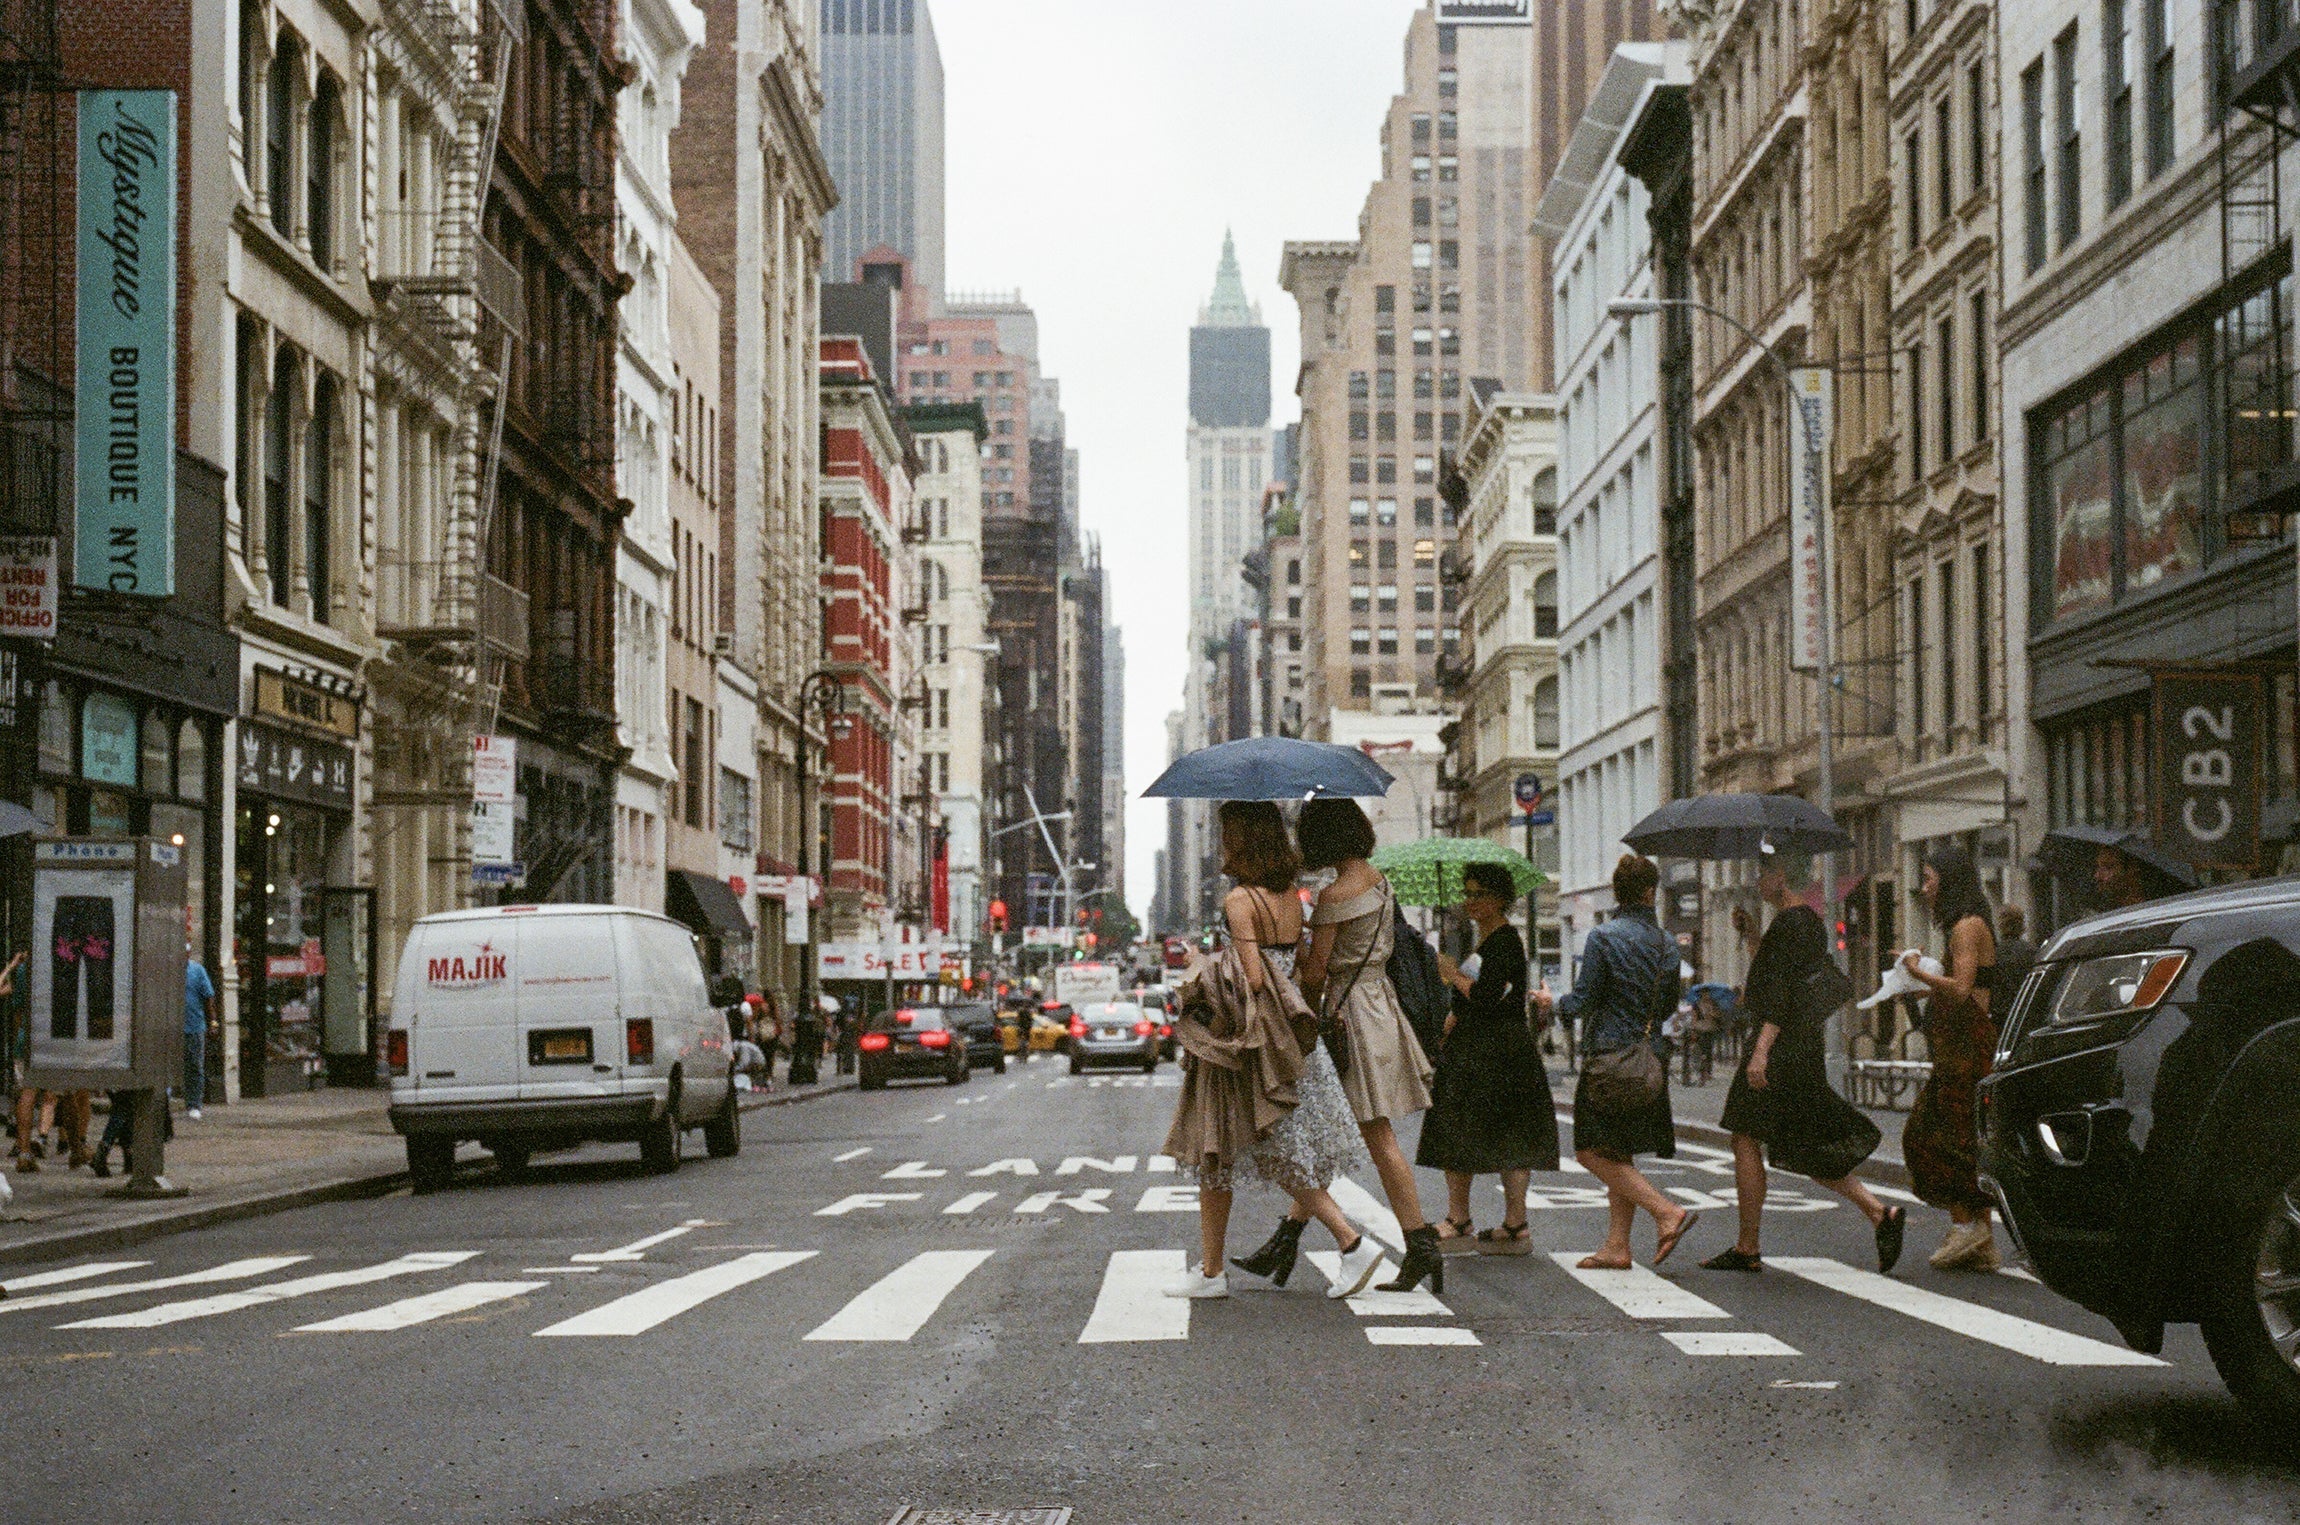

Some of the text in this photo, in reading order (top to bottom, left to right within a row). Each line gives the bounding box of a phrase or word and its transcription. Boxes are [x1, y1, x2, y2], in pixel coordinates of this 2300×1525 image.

[98, 101, 159, 594] Mystique BOUTIQUE NYC
[6, 589, 41, 607] FOR
[2182, 705, 2234, 842] CB2
[53, 843, 117, 856] Phone
[428, 954, 507, 982] MAJIK
[814, 1186, 1201, 1213] FIRE
